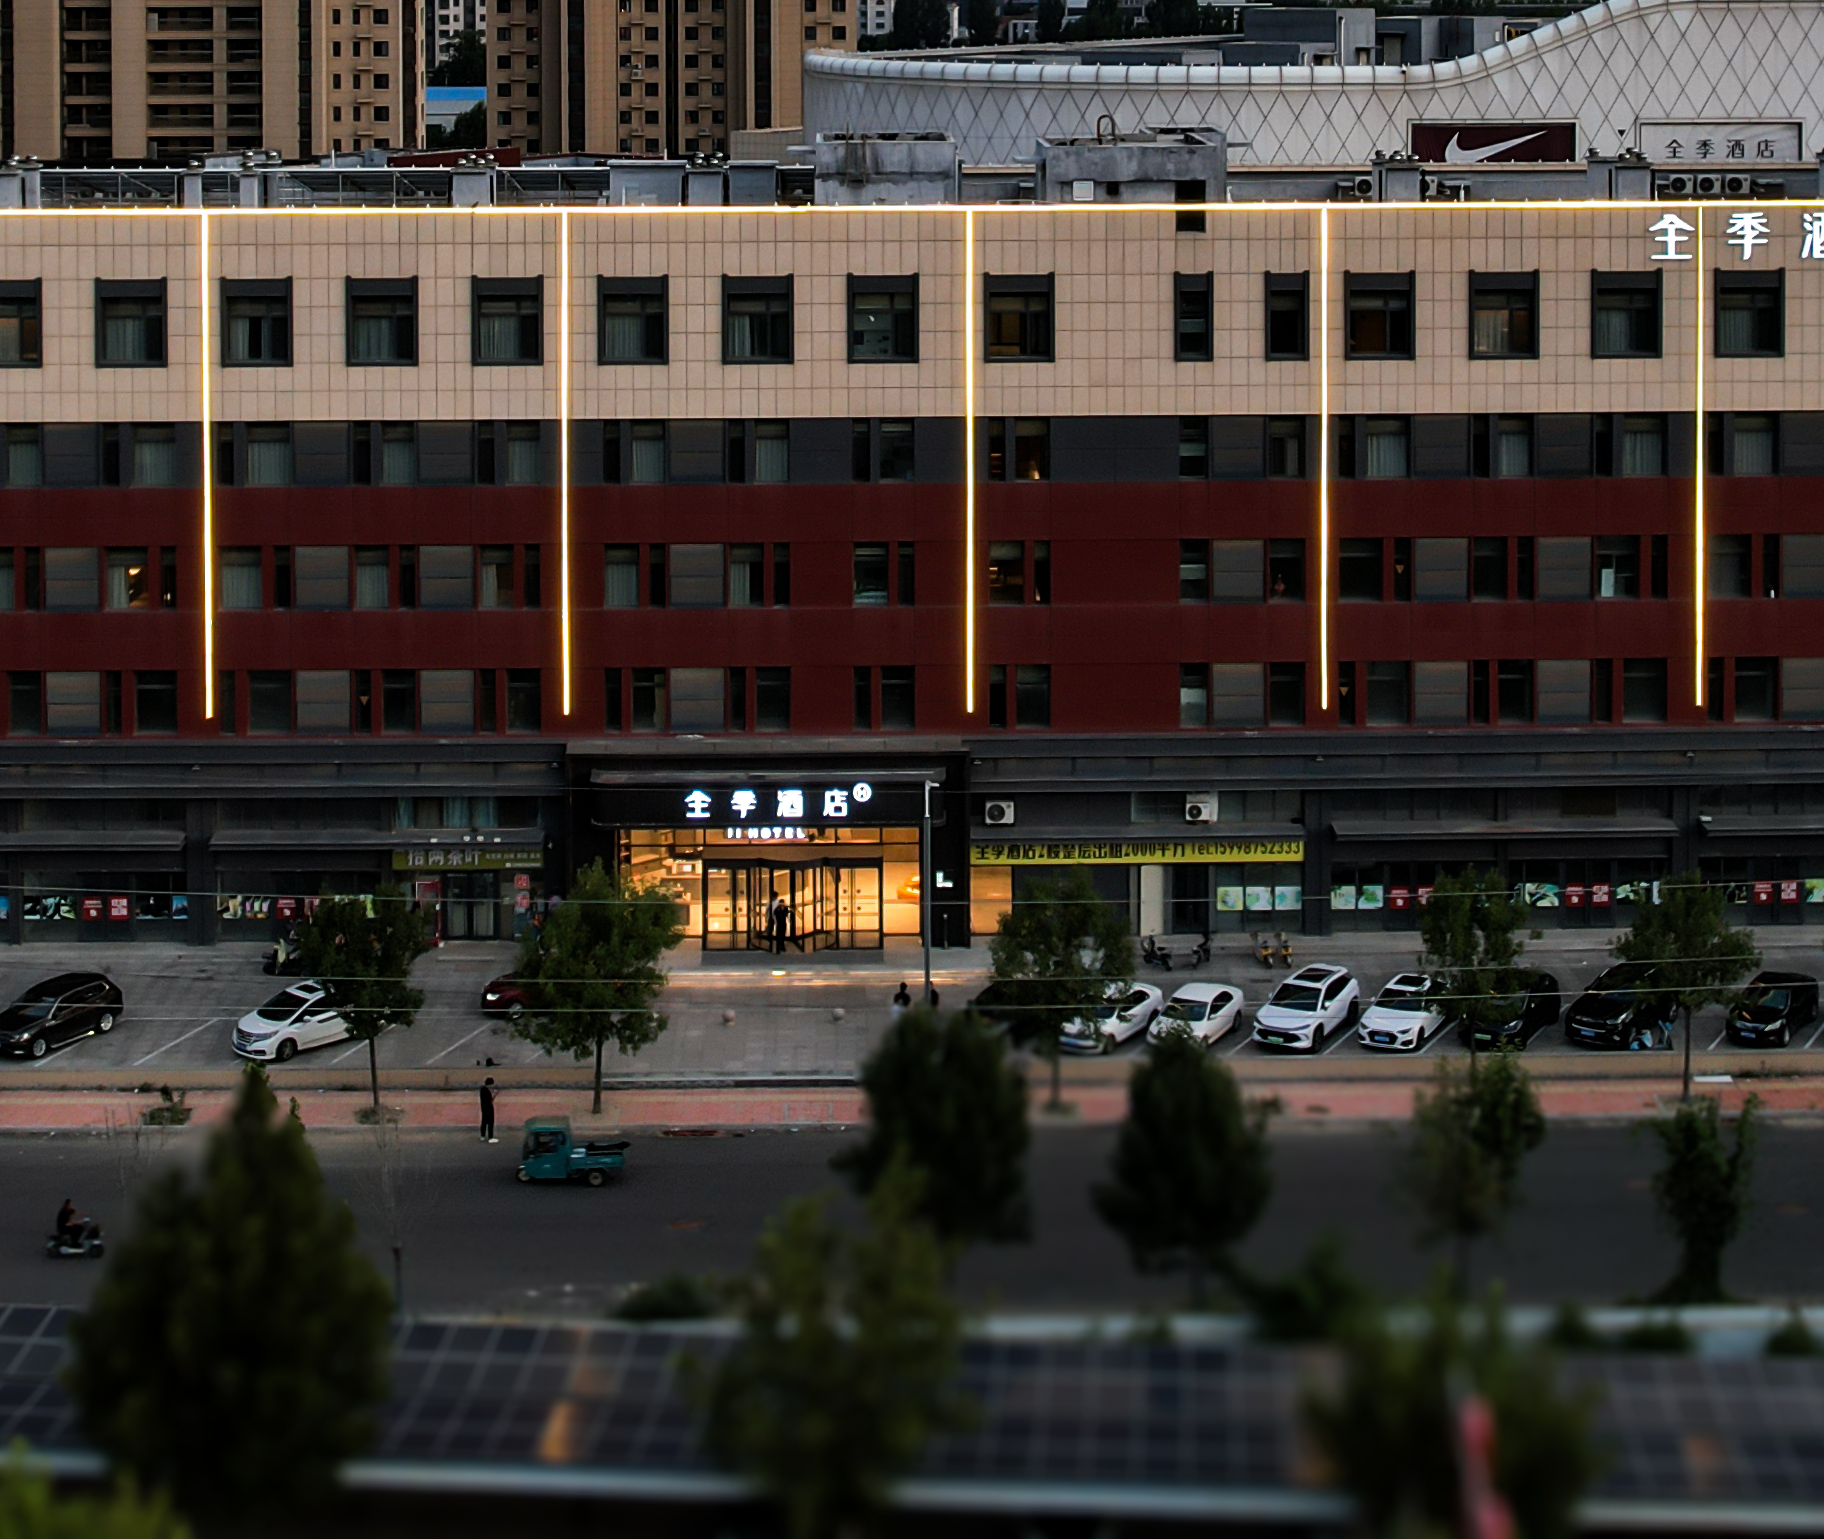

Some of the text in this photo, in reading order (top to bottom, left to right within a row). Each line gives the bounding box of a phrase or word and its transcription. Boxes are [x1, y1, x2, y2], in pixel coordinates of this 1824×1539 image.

[1664, 138, 1776, 160] 全季酒店
[684, 788, 849, 819] 全季酒店
[747, 827, 807, 840] HOTEL
